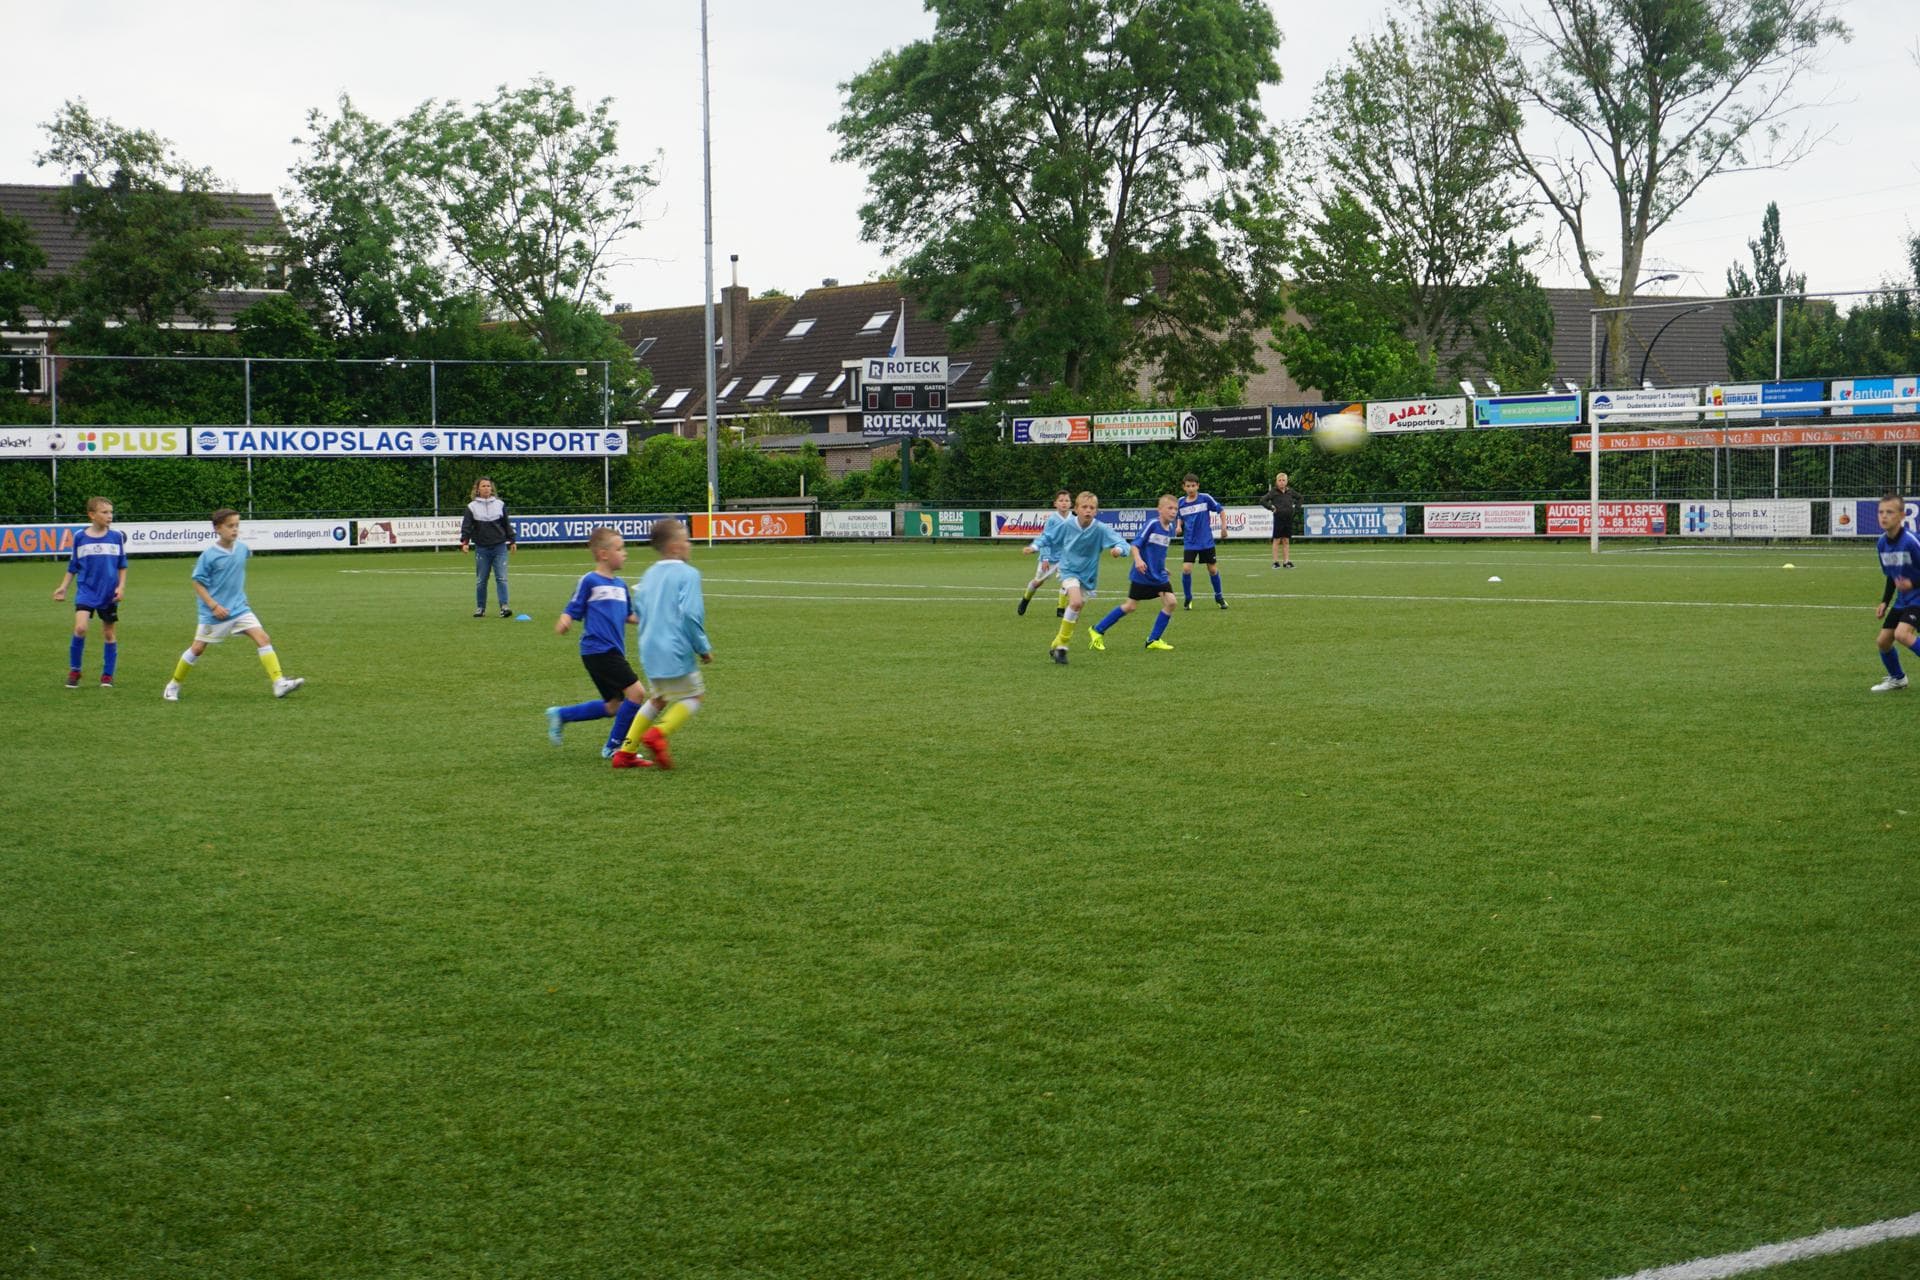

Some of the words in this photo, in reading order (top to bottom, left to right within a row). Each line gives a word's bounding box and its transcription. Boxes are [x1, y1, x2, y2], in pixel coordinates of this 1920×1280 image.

[871, 364, 880, 377] R
[887, 361, 940, 373] ROTECK
[1636, 391, 1661, 401] Transport
[863, 414, 947, 428] ROTECK.NL
[1388, 404, 1428, 425] AJAX
[1096, 414, 1176, 437] HOGENDOORN
[1396, 418, 1446, 428] supporters
[102, 432, 177, 451] PLUS
[222, 431, 414, 451] TANKOPSLAG
[443, 432, 600, 451] TRANSPORT
[1610, 438, 1628, 448] ING
[1647, 436, 1665, 447] ING
[1684, 435, 1701, 445] ING
[1722, 433, 1741, 444] ING
[1761, 432, 1781, 443] ING
[1801, 431, 1821, 442] ING
[1883, 429, 1904, 440] ING
[939, 511, 963, 522] BREIJS
[1429, 511, 1480, 520] REVER
[1548, 505, 1622, 517] AUTOBERIJF
[1624, 504, 1664, 516] D.SPEK
[1712, 510, 1724, 518] De
[711, 519, 755, 537] ING
[1328, 513, 1381, 528] XANTHI
[1612, 518, 1624, 526] 68
[1627, 518, 1648, 526] 1350
[132, 530, 146, 540] de
[149, 529, 218, 544] Onderlingen
[273, 527, 331, 540] onderlingen.nl
[520, 522, 559, 537] ROOK
